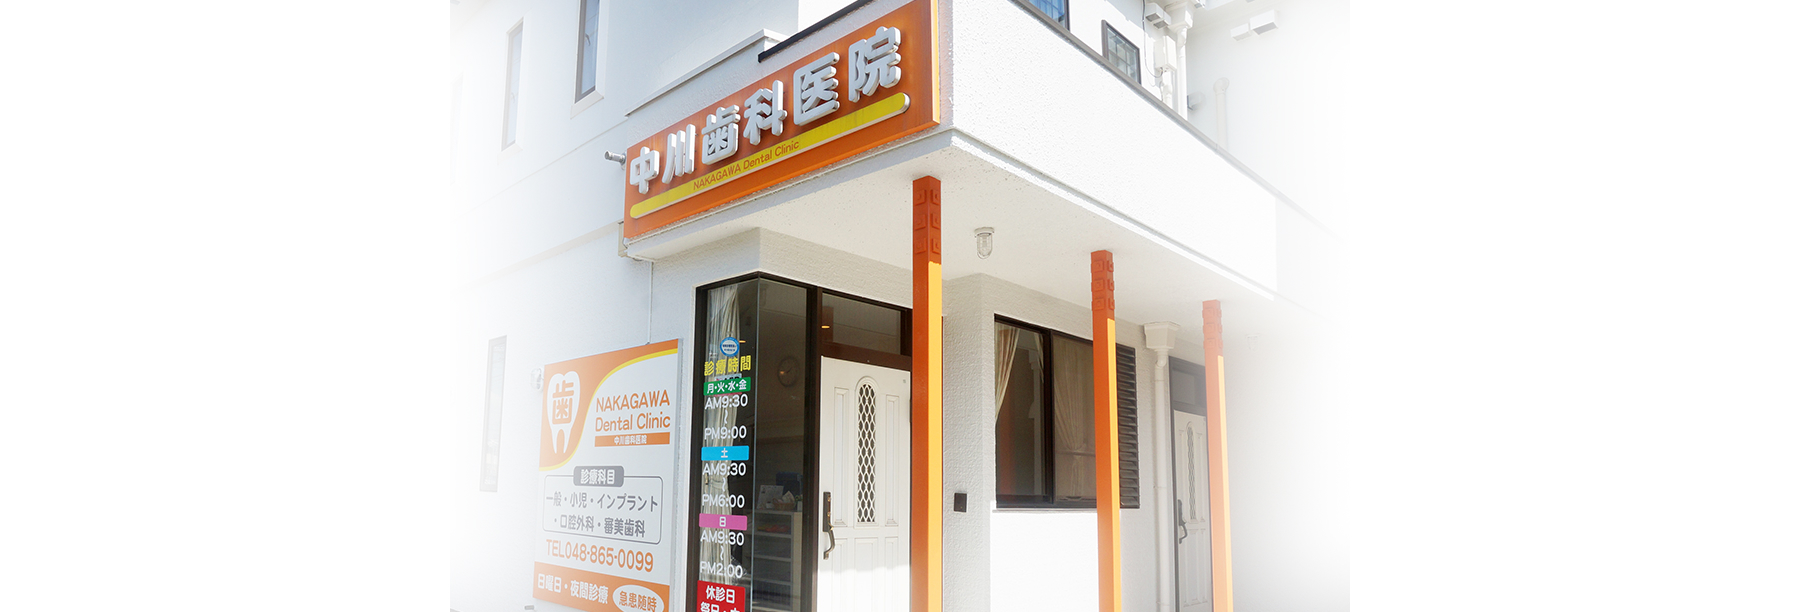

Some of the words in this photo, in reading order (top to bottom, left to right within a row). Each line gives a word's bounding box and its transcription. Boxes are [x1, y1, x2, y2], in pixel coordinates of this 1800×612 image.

[630, 26, 901, 194] 中川歯科医院
[693, 163, 742, 190] NAKAGAWA
[743, 150, 772, 170] Dental
[774, 140, 800, 157] Clinic
[704, 355, 751, 376] 診療時間
[707, 379, 747, 394] 月・火・水・金
[552, 379, 575, 425] 歯
[596, 389, 670, 412] NAKAGAWA
[704, 393, 748, 410] AM9:30
[595, 414, 633, 432] Dental
[637, 411, 671, 430] Clinic
[614, 434, 647, 445] 中川歯科医院
[704, 425, 747, 440] PM9:00
[720, 447, 728, 458] 土
[580, 468, 616, 485] 診療科目
[702, 462, 746, 476] AM9:30
[546, 491, 658, 512] 一般・小児・インプラント
[702, 493, 745, 508] PM6:00
[719, 516, 727, 527] 日
[700, 529, 745, 546] AM9:30
[700, 561, 743, 579] PM2:00
[537, 573, 609, 604] 日曜日・夜間診療
[705, 585, 736, 604] 休診日
[619, 590, 657, 612] 急患随時
